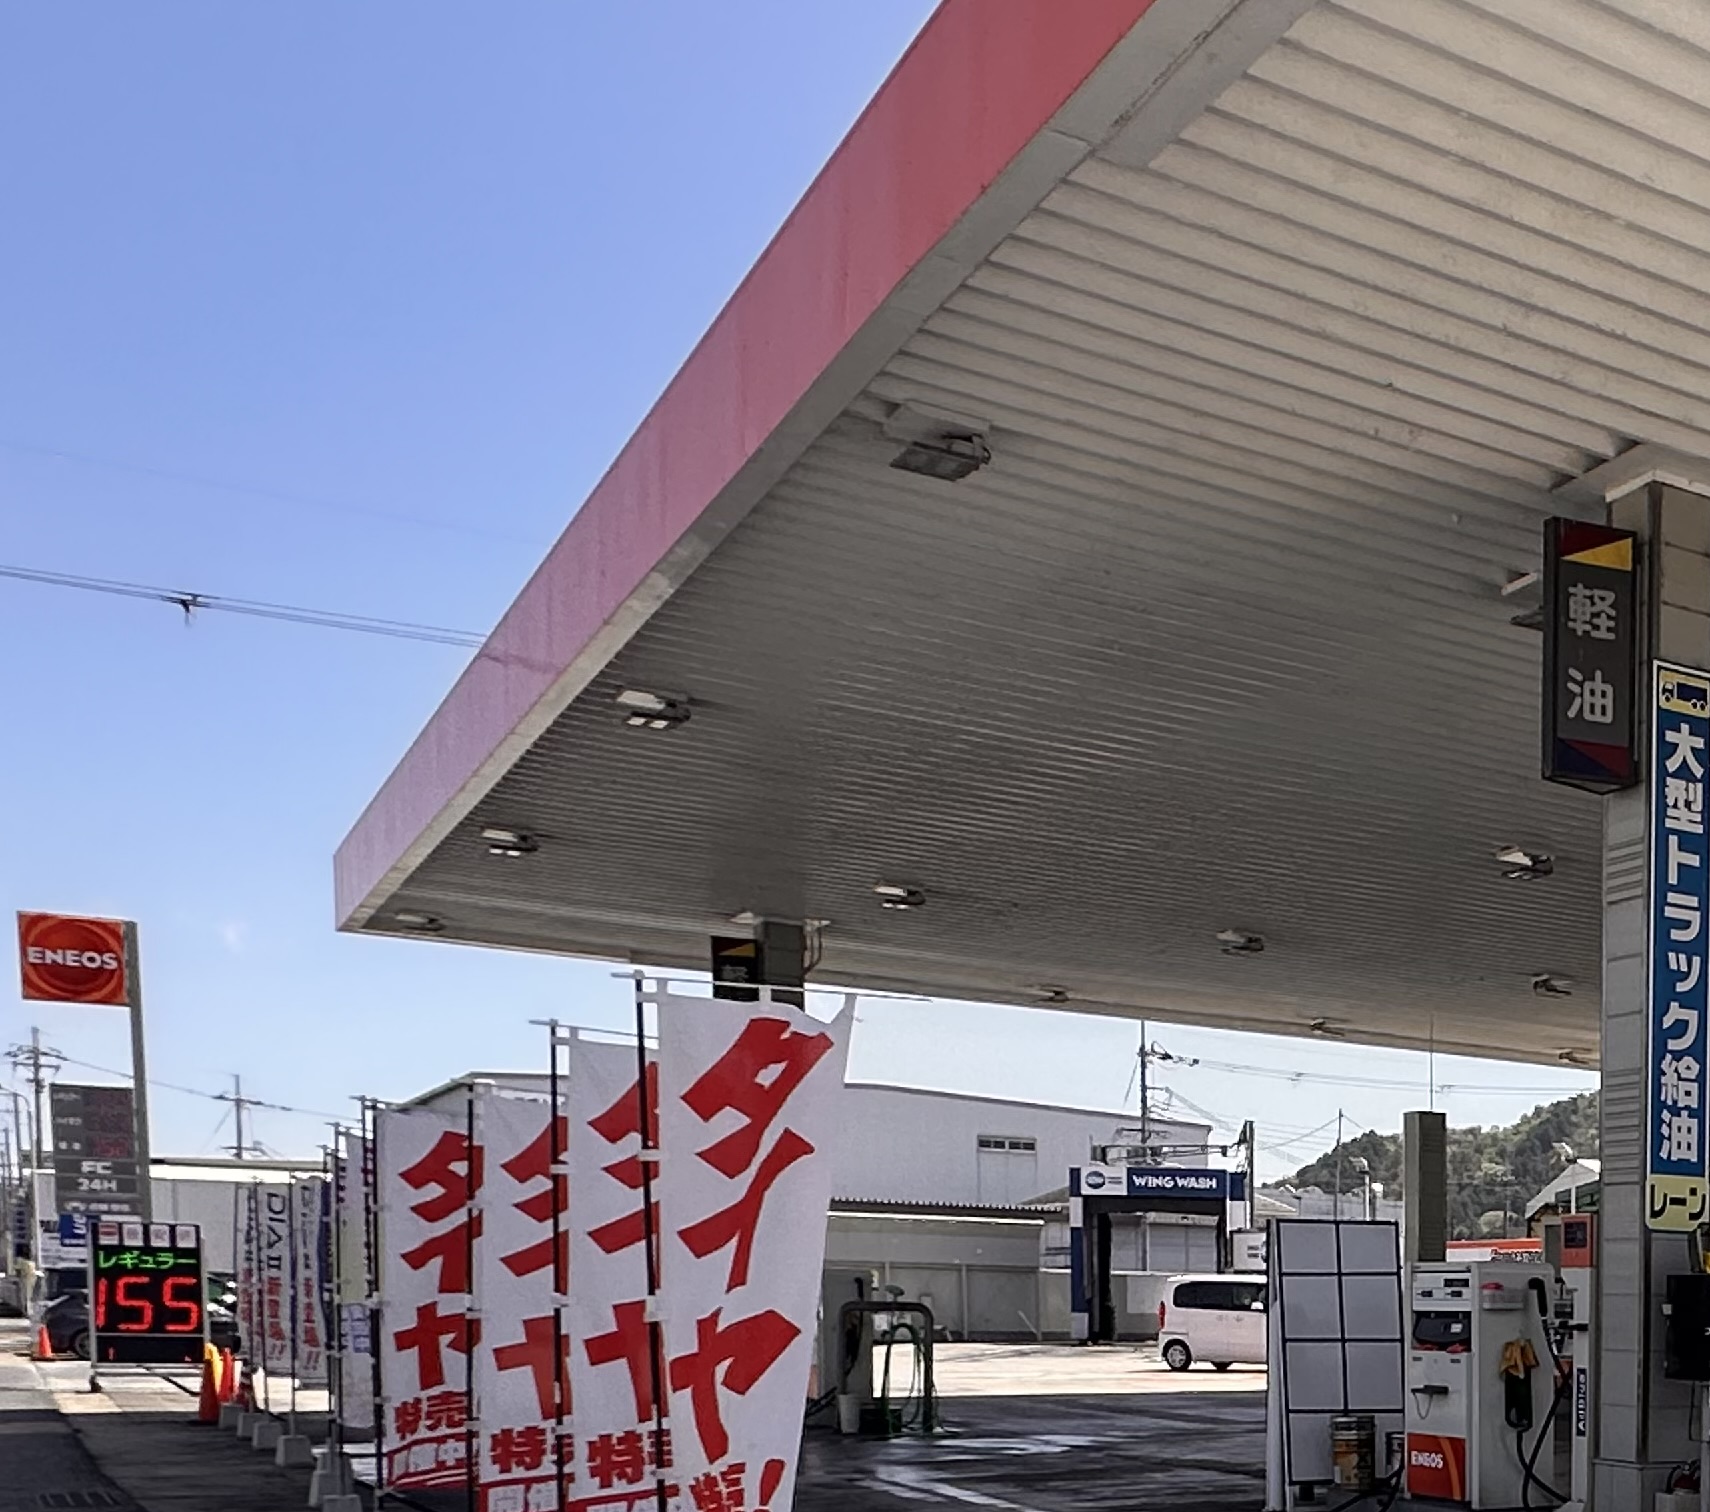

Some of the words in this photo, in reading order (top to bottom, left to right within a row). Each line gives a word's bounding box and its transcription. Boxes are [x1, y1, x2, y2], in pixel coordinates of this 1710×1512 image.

[1566, 582, 1616, 724] 軽油
[28, 945, 118, 971] ENEOS
[1660, 721, 1705, 1163] 大型トラック給油
[1132, 1174, 1174, 1188] WING
[1175, 1176, 1217, 1189] WASH
[1650, 1182, 1706, 1221] レーン
[97, 1250, 198, 1270] レギュラー
[394, 1130, 484, 1391] タイヤ
[669, 1016, 833, 1464] タイヤ
[96, 1276, 199, 1331] 155
[1410, 1451, 1443, 1469] ENEOS
